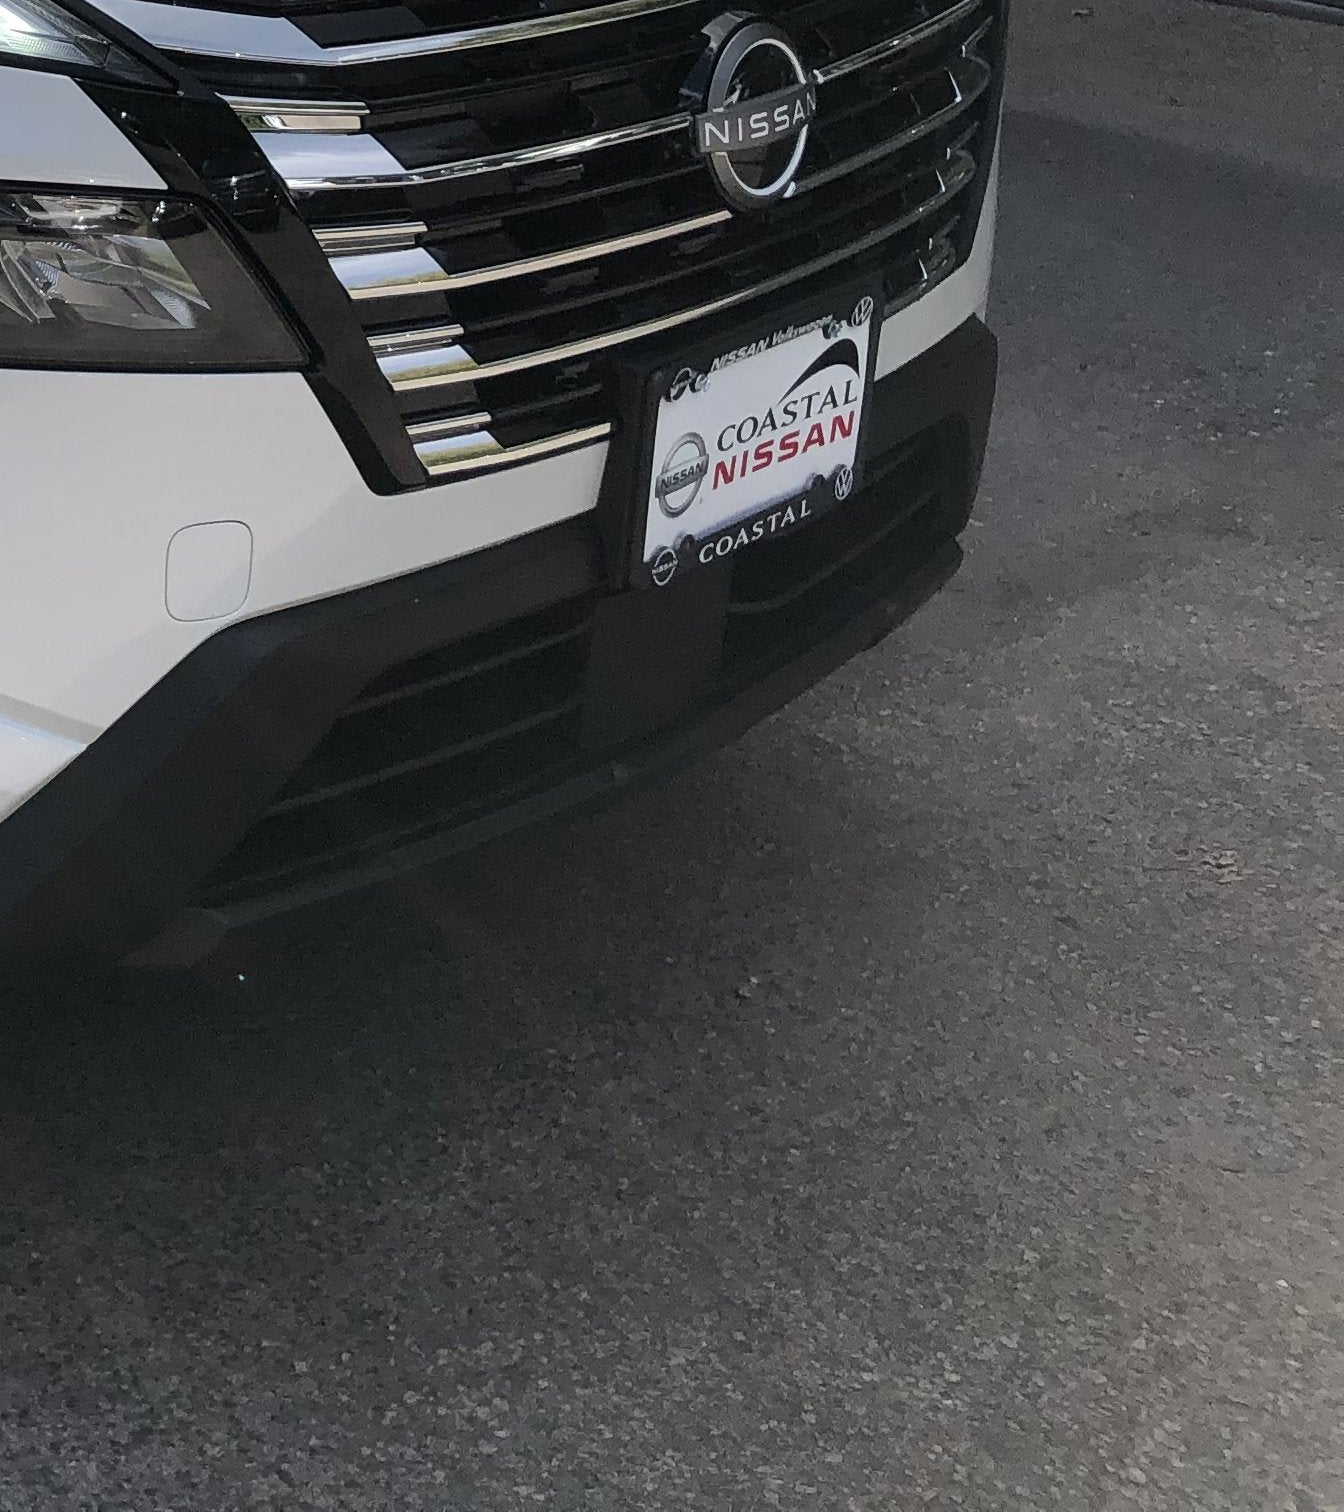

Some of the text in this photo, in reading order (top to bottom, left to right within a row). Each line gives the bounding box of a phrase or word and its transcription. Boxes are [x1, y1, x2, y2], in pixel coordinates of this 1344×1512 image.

[705, 92, 816, 147] NISSAN
[711, 339, 770, 371] NISSAN
[716, 379, 858, 452] COASTAL
[660, 460, 705, 490] NISSAN
[712, 410, 855, 490] NISSAN
[698, 499, 812, 564] COASTAL
